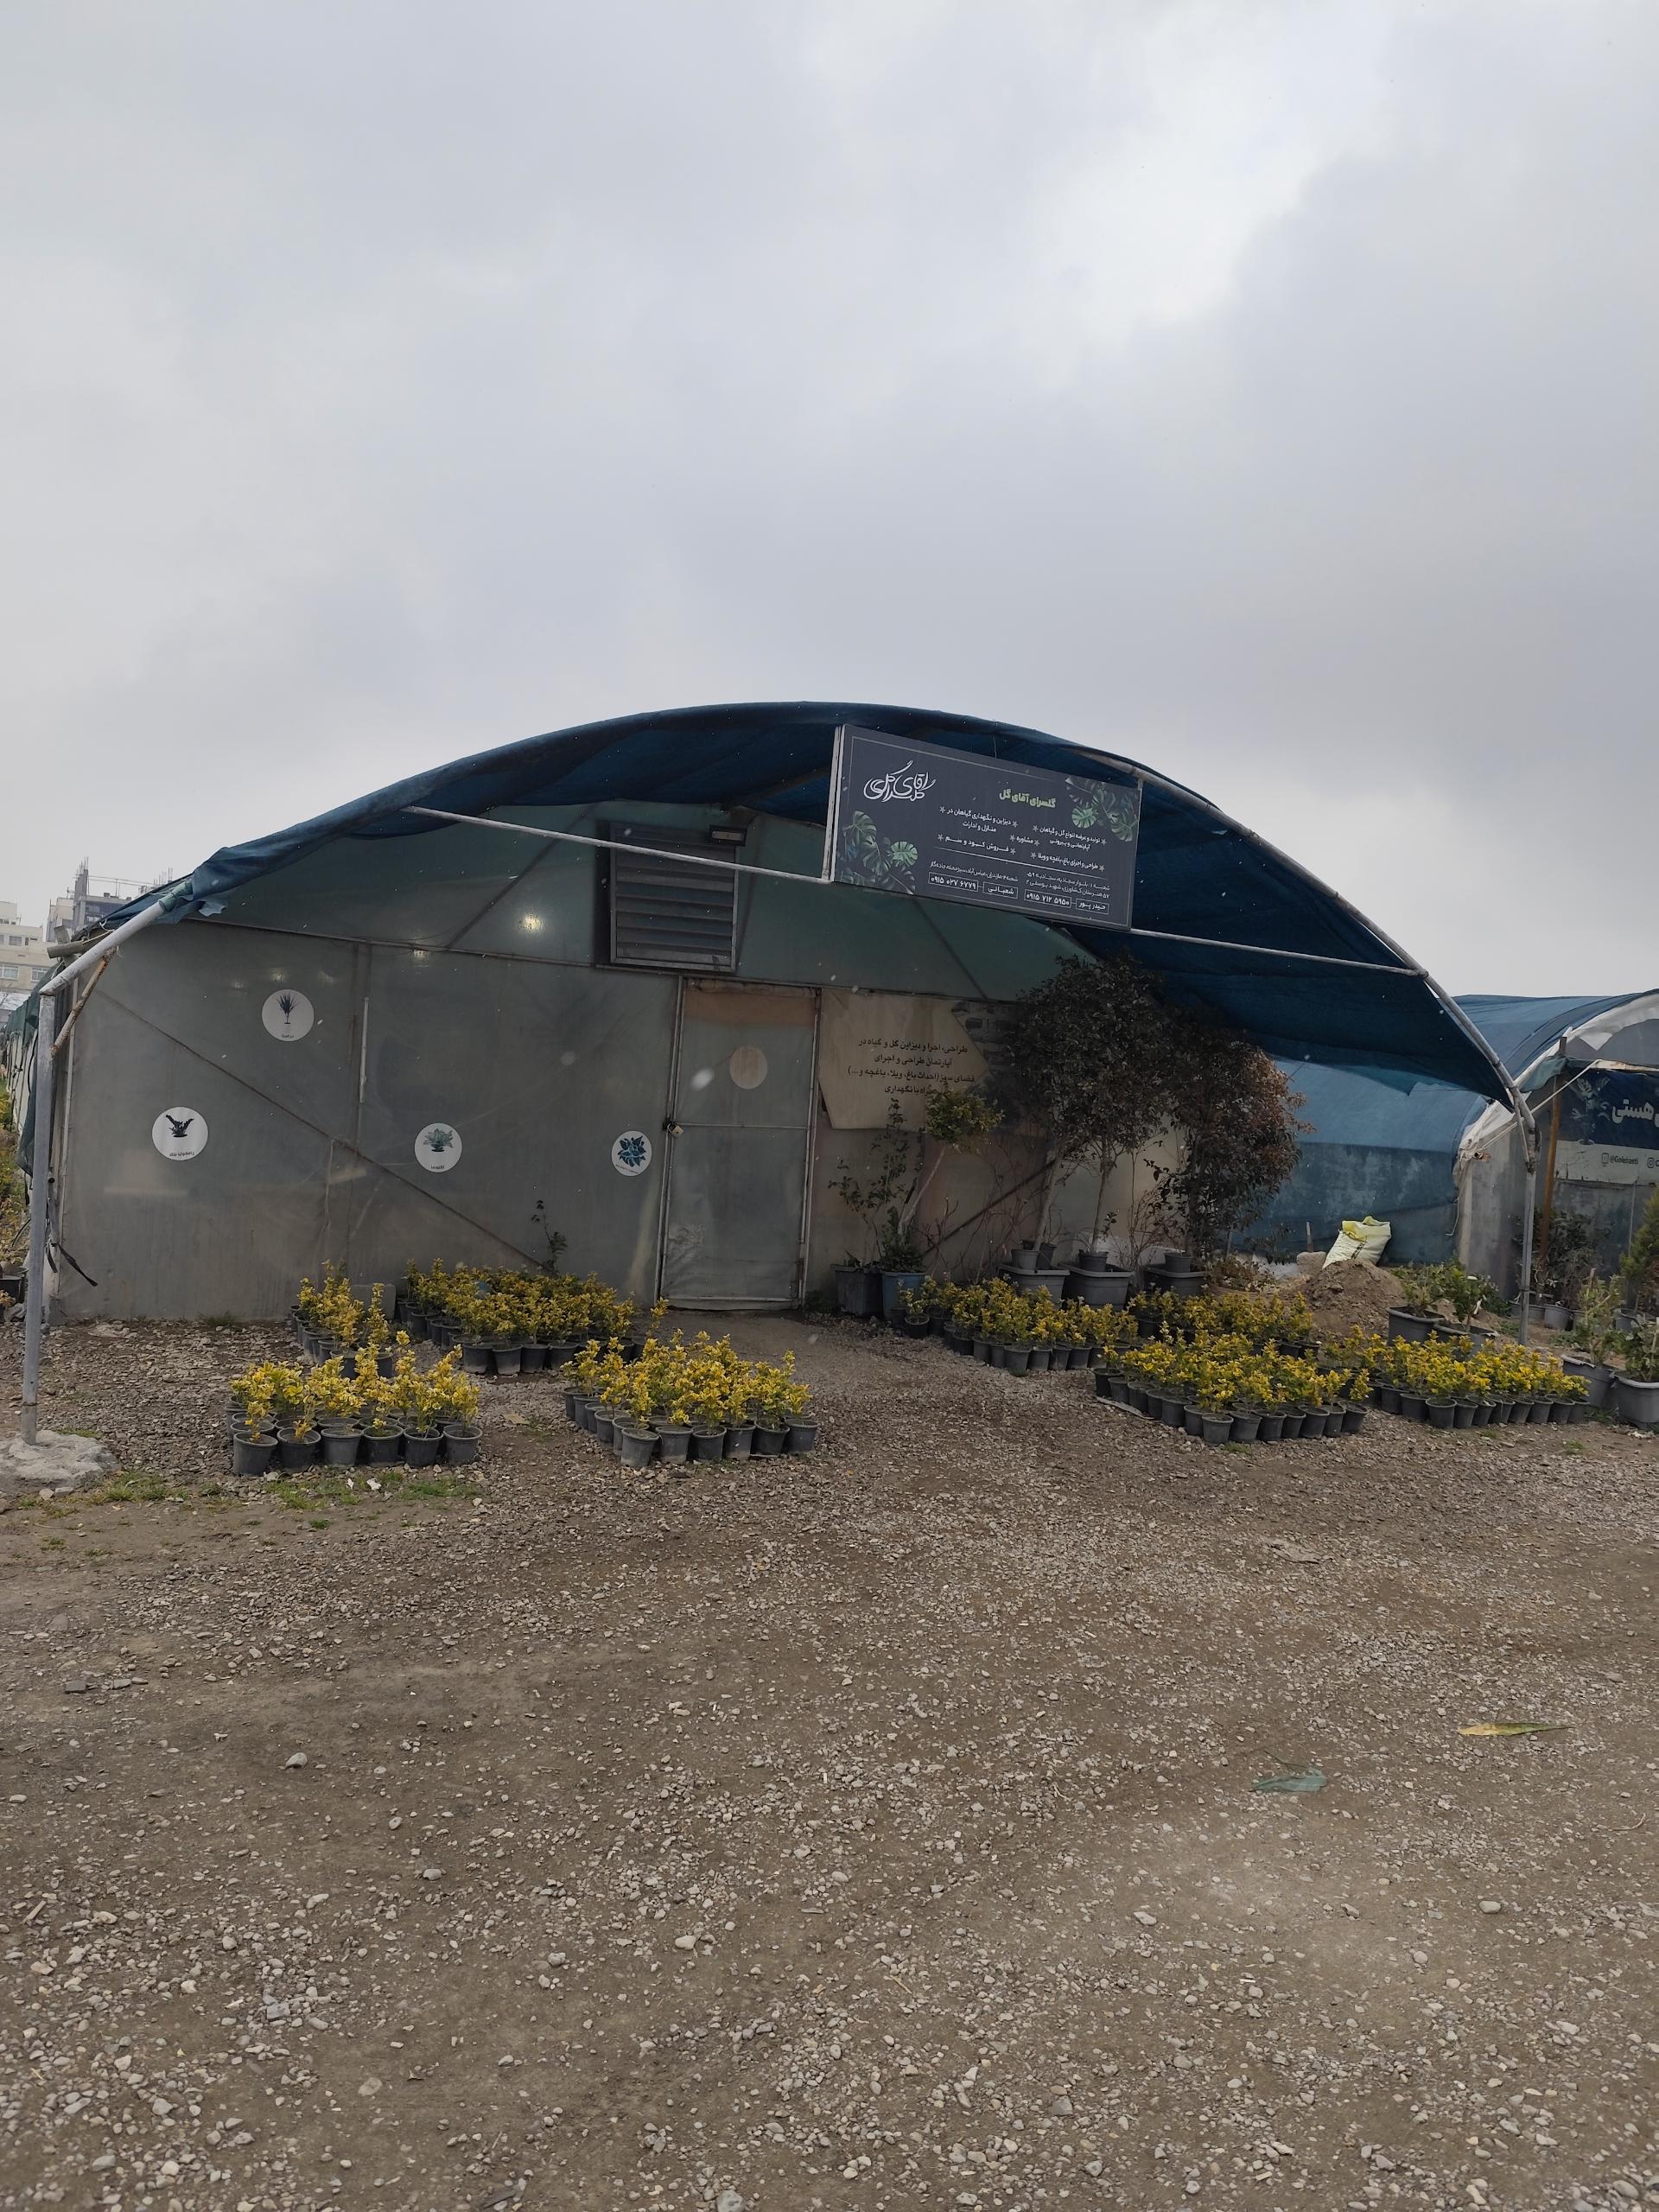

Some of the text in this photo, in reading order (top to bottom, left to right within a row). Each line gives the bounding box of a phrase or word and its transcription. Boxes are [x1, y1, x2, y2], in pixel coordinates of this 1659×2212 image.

[999, 788, 1056, 808] گلسرای آقای گل
[954, 809, 971, 817] گیاهان
[1016, 836, 1034, 844] مشاوره
[986, 843, 1009, 852] فروش
[988, 887, 1014, 895] شعبانی
[868, 1038, 882, 1047] گیاه
[889, 1039, 899, 1048] گل
[899, 1041, 921, 1051] دیزاین
[927, 1043, 941, 1052] اجرا
[874, 1053, 894, 1064] اجرای
[901, 1057, 925, 1066] طراحی
[865, 1068, 886, 1077] باغچه
[884, 1084, 912, 1094] نگهداری
